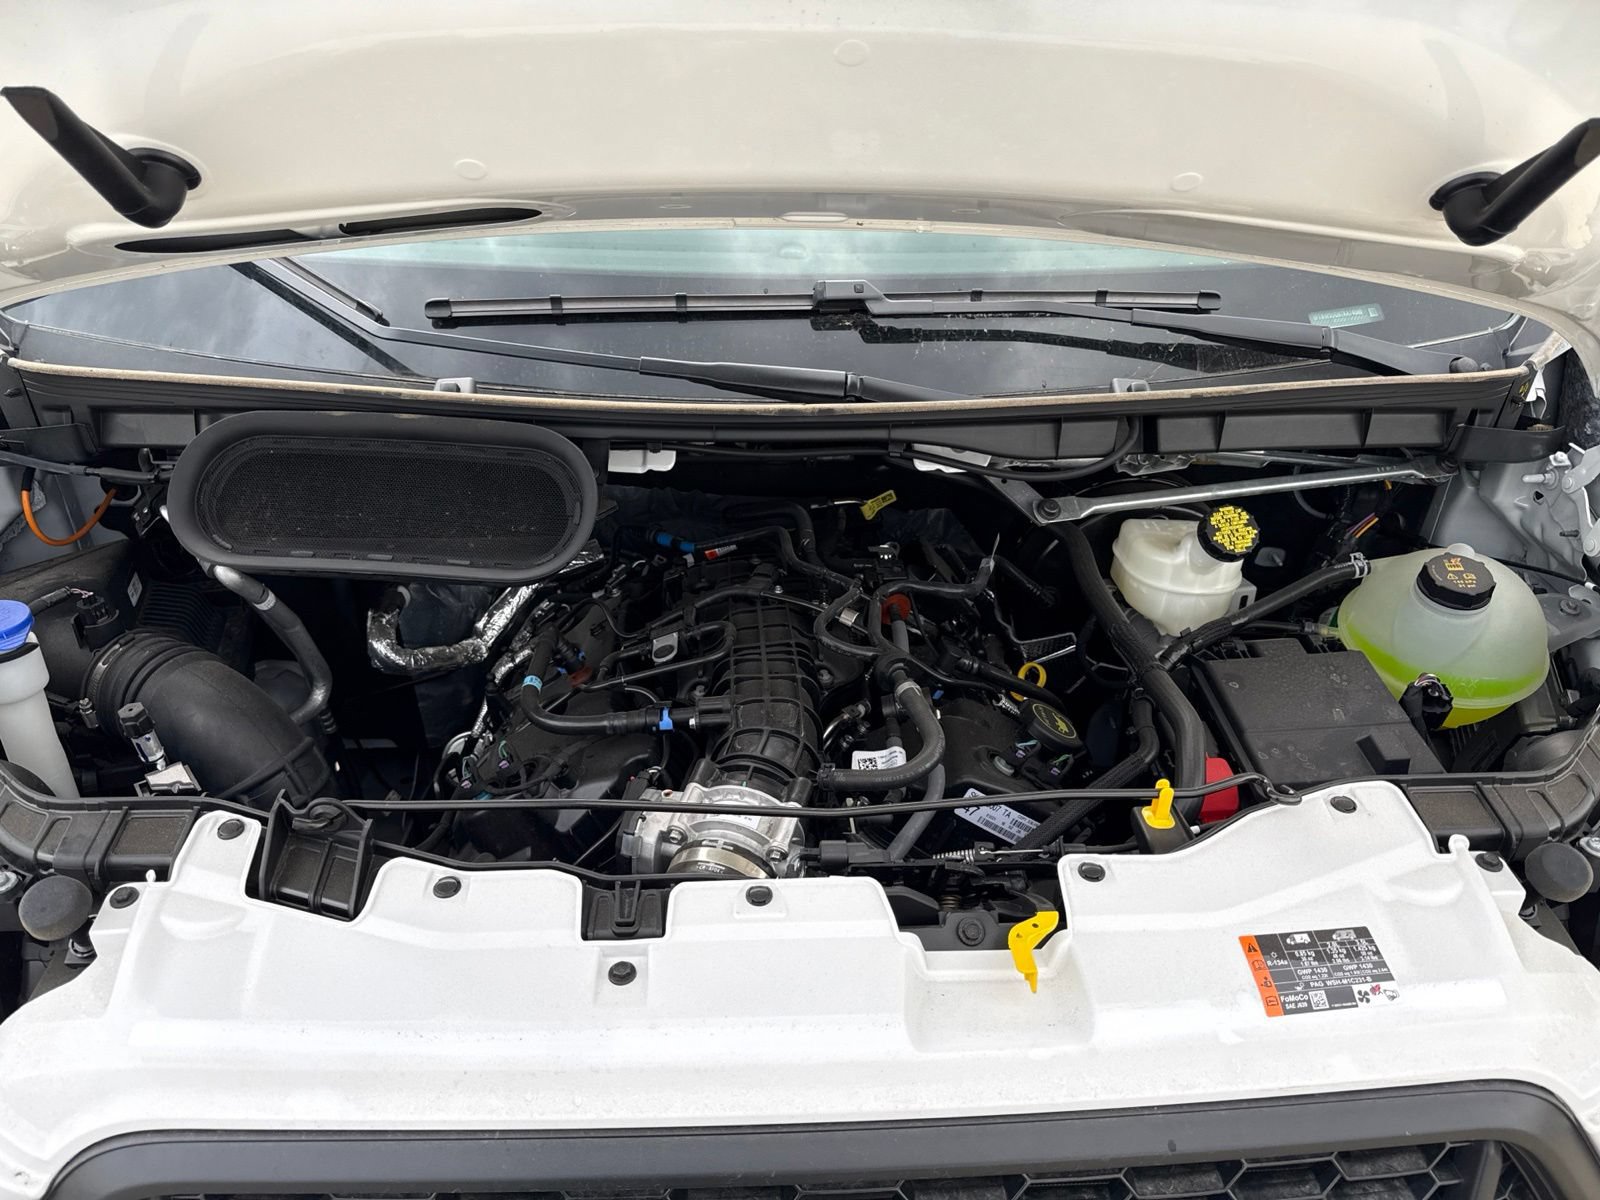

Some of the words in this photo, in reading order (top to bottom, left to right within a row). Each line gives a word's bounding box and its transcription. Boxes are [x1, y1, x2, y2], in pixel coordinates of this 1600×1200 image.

[1266, 959, 1288, 967] R-134a
[1310, 980, 1325, 988] PAG
[1280, 993, 1309, 1003] FoMoCo
